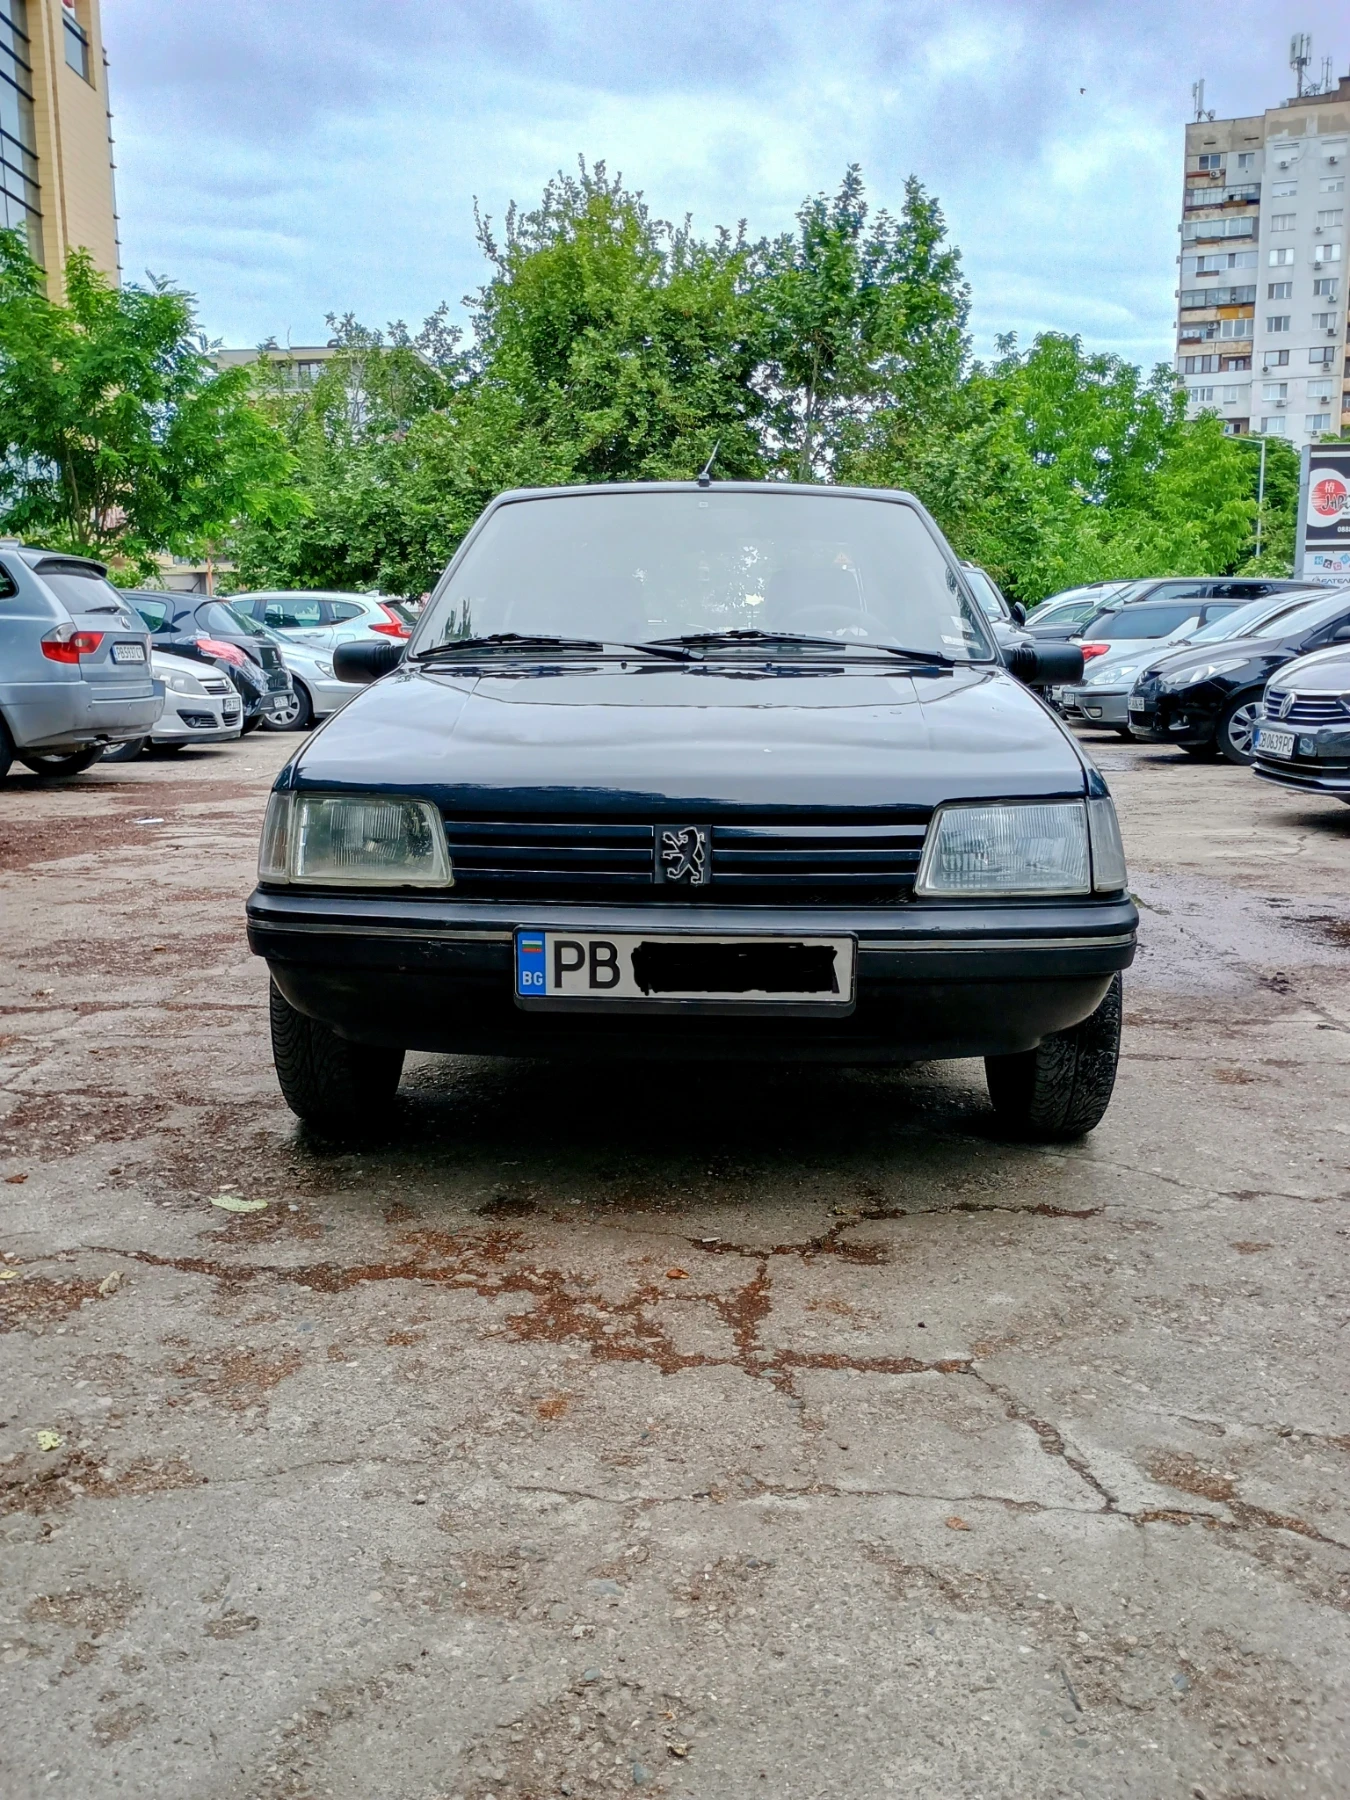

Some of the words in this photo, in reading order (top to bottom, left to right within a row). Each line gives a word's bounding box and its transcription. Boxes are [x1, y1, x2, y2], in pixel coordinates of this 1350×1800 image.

[1258, 731, 1293, 753] CB0639PC
[553, 940, 621, 989] PB
[522, 970, 544, 987] BG
